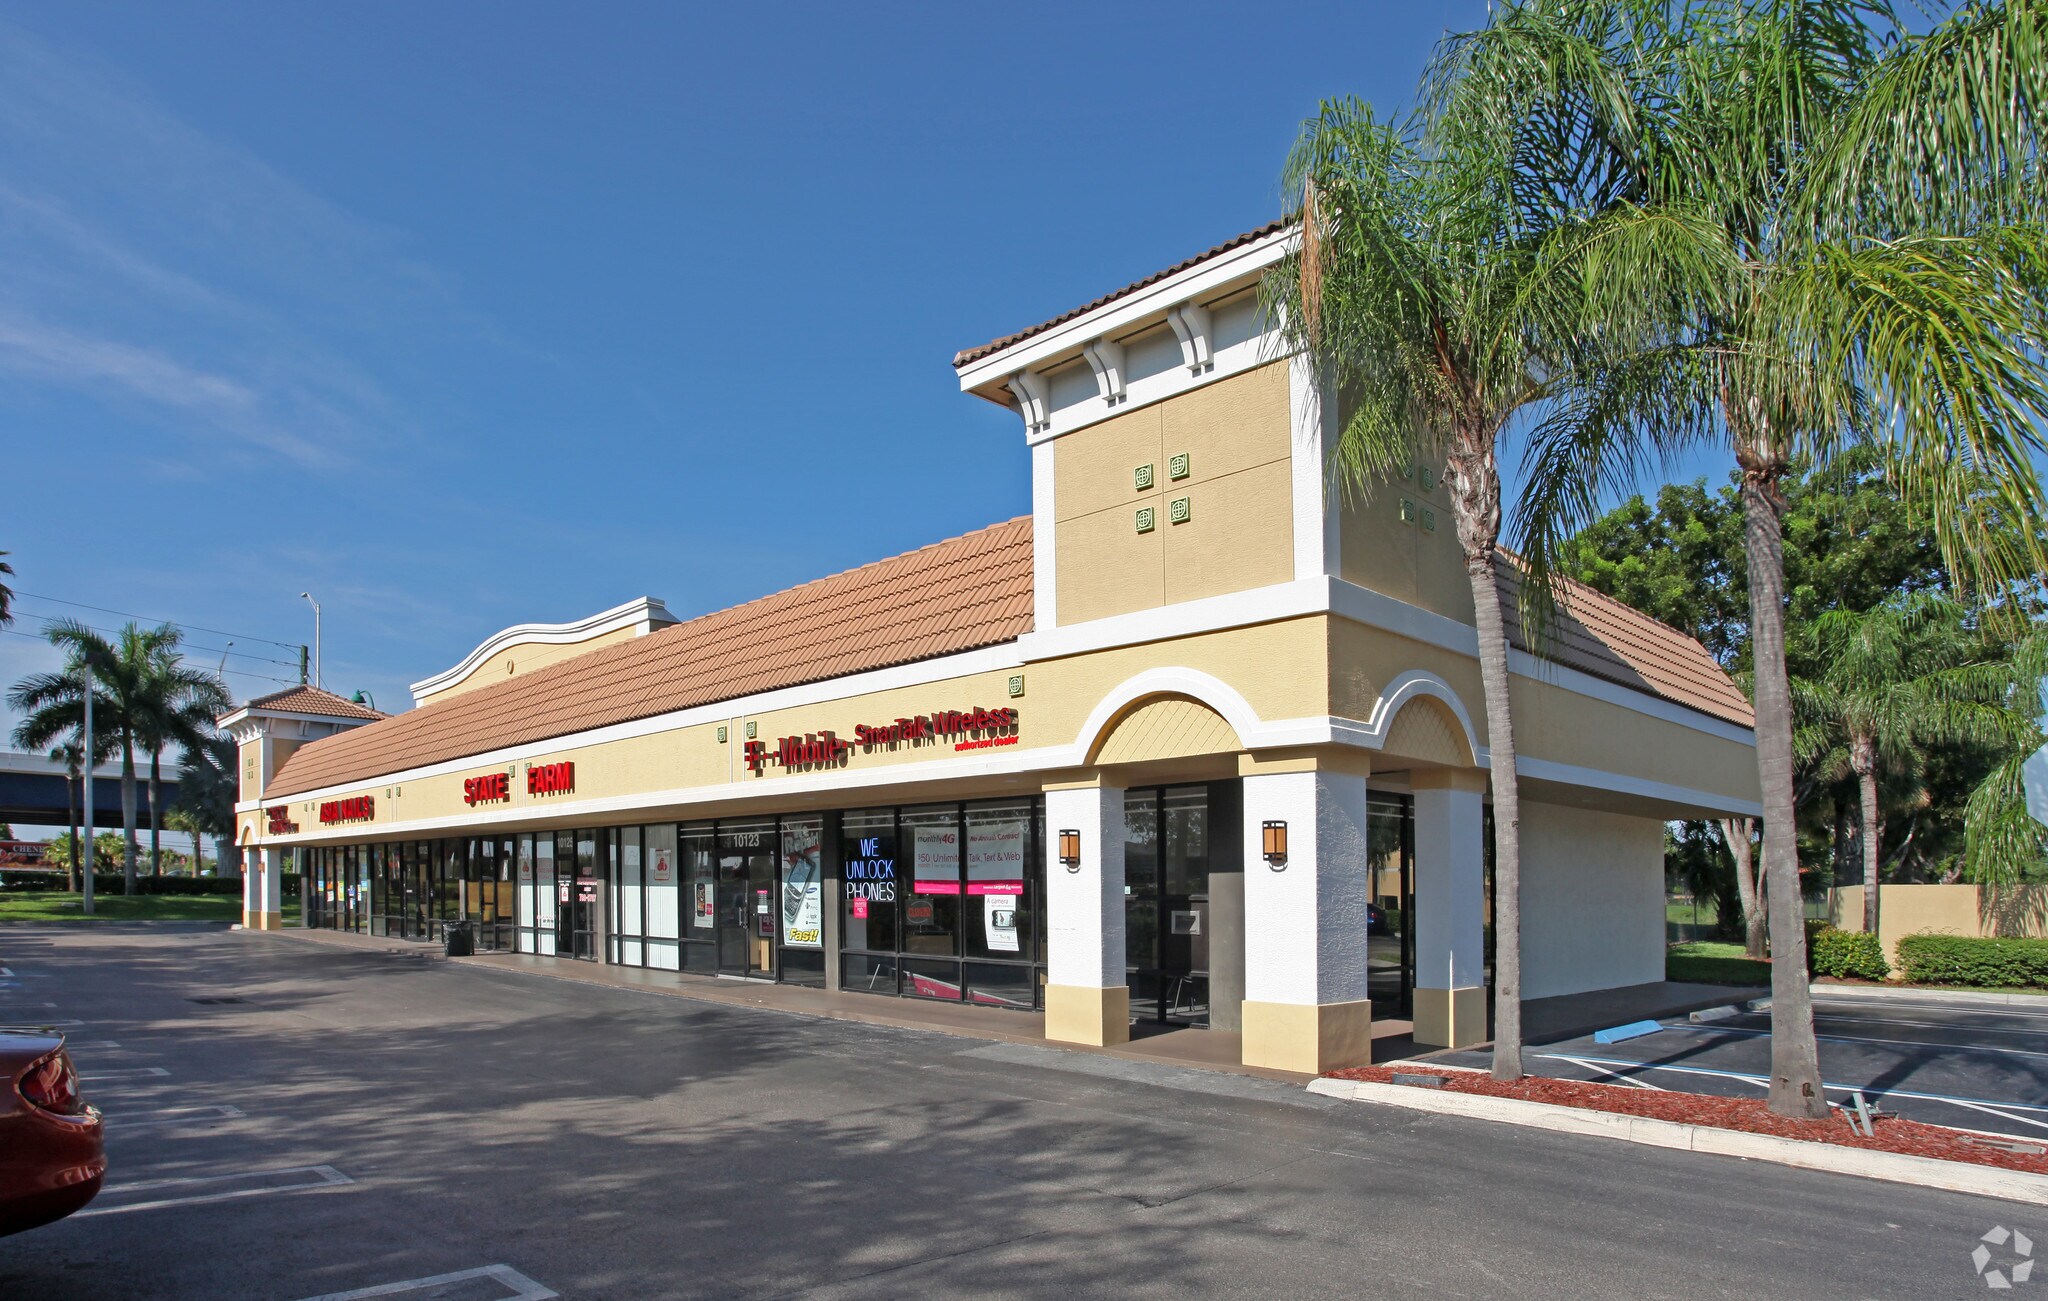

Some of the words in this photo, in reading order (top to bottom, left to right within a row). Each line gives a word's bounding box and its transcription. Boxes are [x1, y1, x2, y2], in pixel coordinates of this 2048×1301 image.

[854, 715, 928, 746] SmarTalk
[931, 706, 1011, 735] Wireless
[955, 738, 993, 751] authorized
[993, 735, 1019, 748] dealer
[463, 773, 506, 804] STATE
[527, 761, 574, 795] FARM
[341, 795, 371, 820] NAILS
[733, 834, 760, 848] 10123
[997, 832, 1020, 841] Contract
[860, 837, 879, 857] WE
[983, 852, 996, 862] Text
[996, 852, 1003, 861] &
[1004, 852, 1021, 861] Web
[845, 860, 894, 879] UNLOCK
[846, 882, 895, 901] PHONES
[789, 927, 819, 942] Fast!
